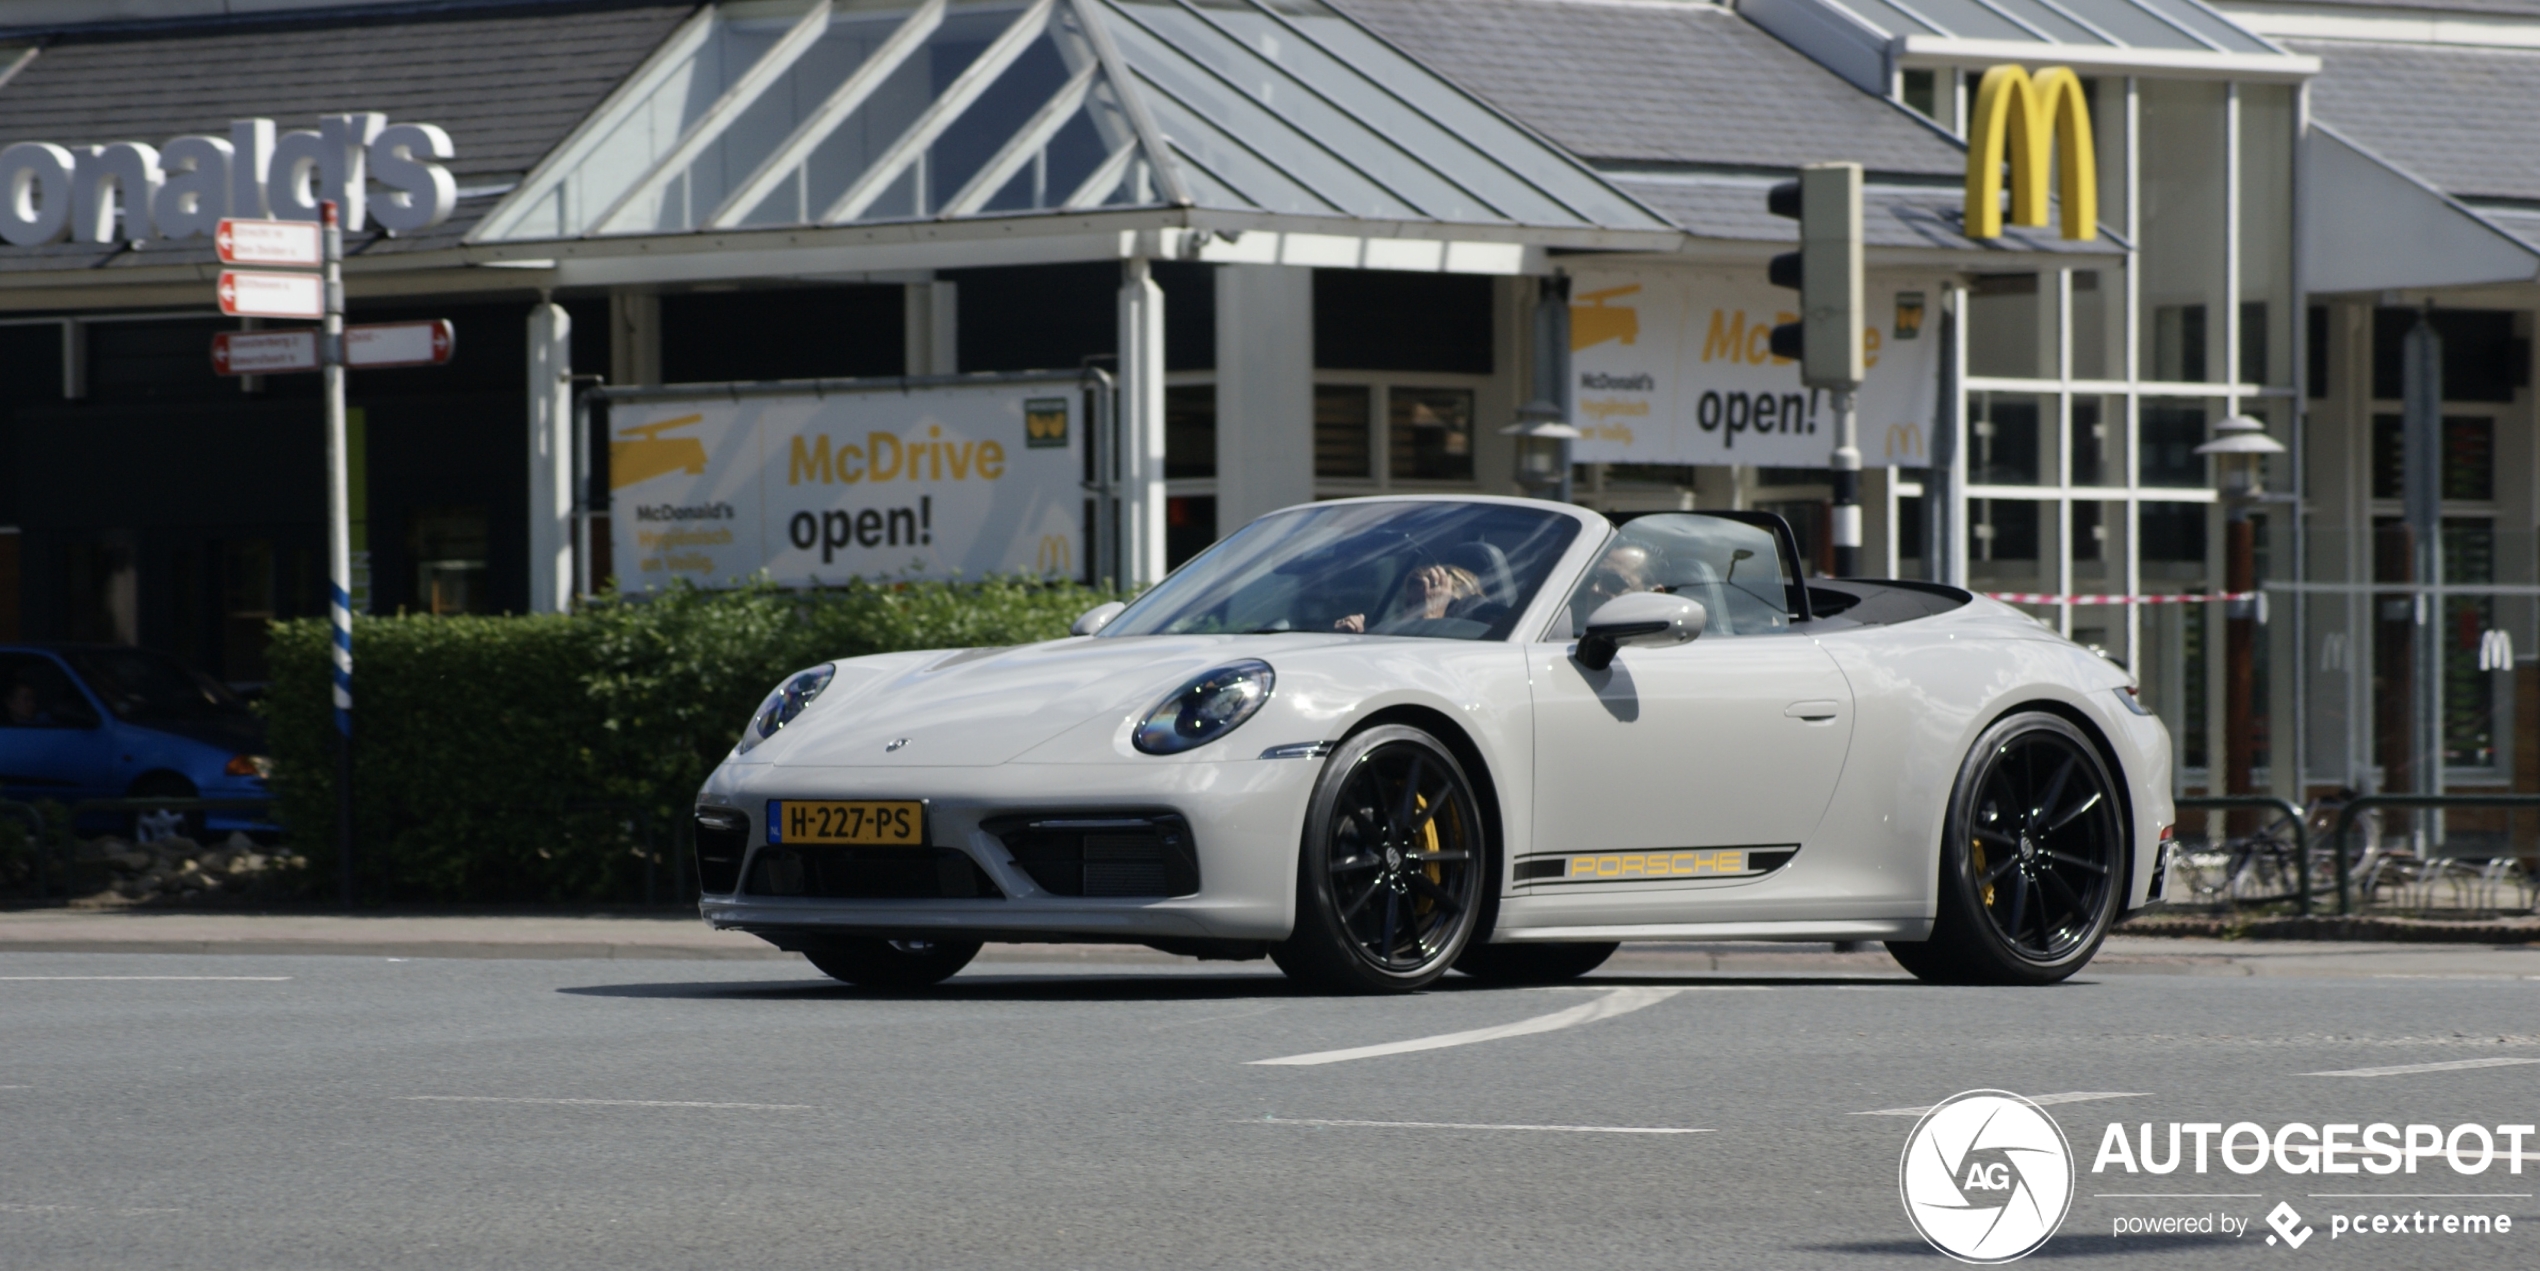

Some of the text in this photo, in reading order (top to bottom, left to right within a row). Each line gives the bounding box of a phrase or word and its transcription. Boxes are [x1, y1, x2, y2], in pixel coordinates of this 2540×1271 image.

[1697, 386, 1820, 448] open!
[788, 423, 1006, 486] McDrive
[637, 502, 735, 521] McDonald's
[789, 495, 932, 565] open!
[791, 806, 911, 839] H-227-PS
[1571, 851, 1742, 877] PORSCHE
